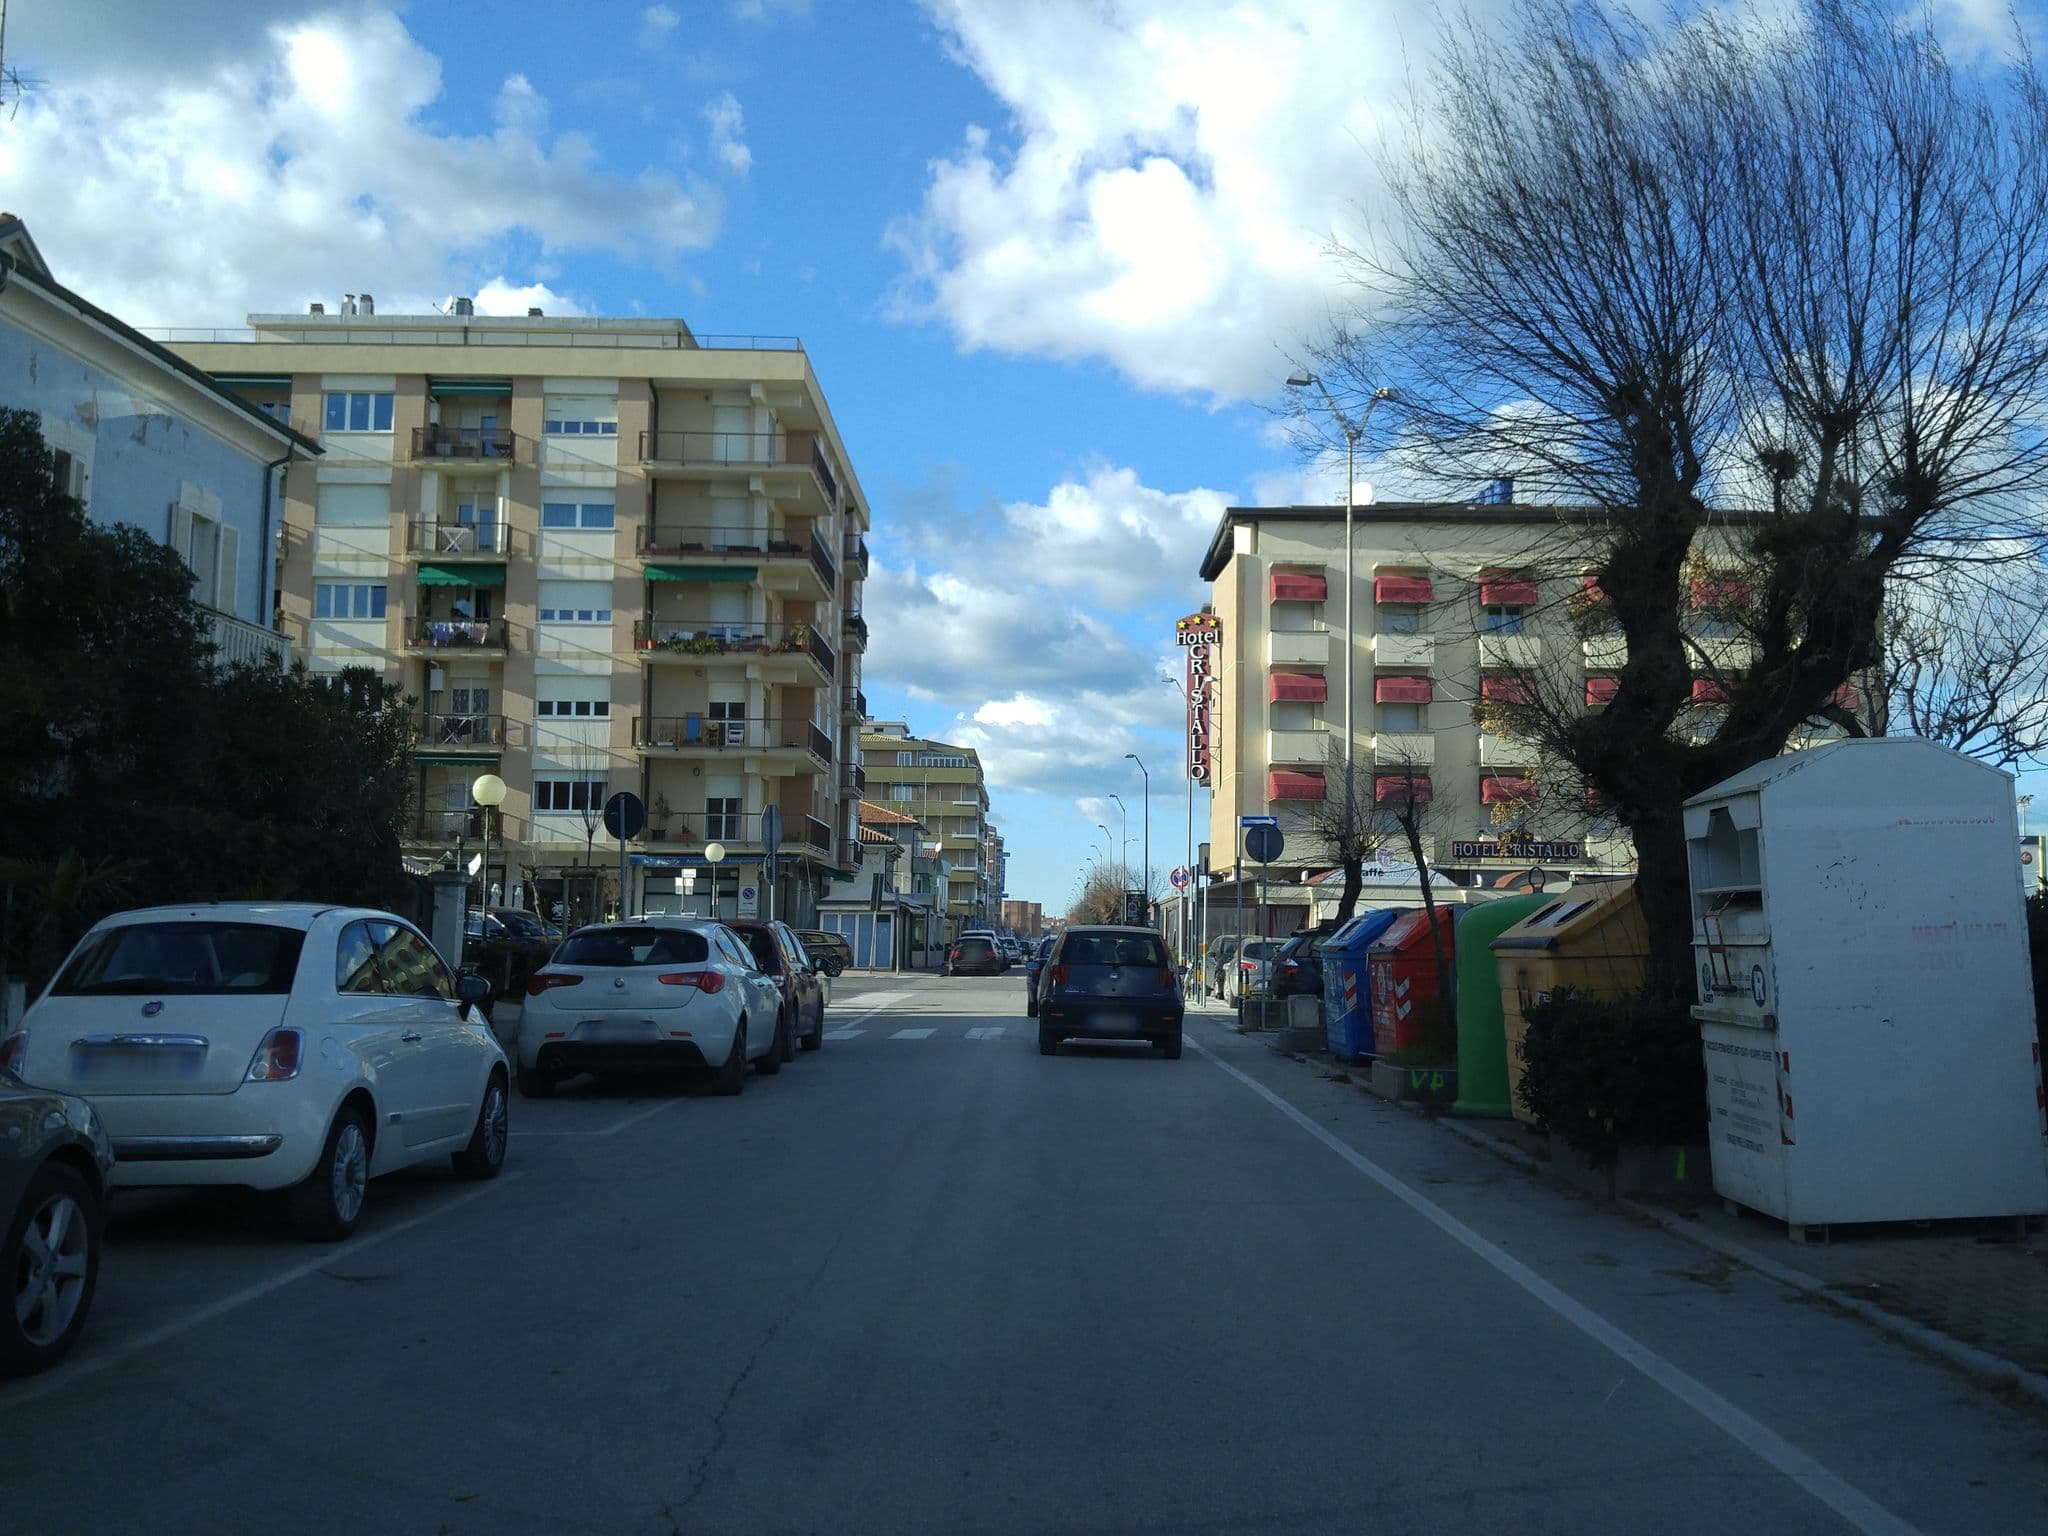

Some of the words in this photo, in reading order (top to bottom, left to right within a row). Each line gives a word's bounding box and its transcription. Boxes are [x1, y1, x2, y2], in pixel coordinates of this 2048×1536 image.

[1176, 630, 1220, 646] Hotel
[1190, 645, 1207, 779] CRISTALLO
[1453, 843, 1498, 856] HOTEL
[1505, 843, 1579, 857] CRISTALLO
